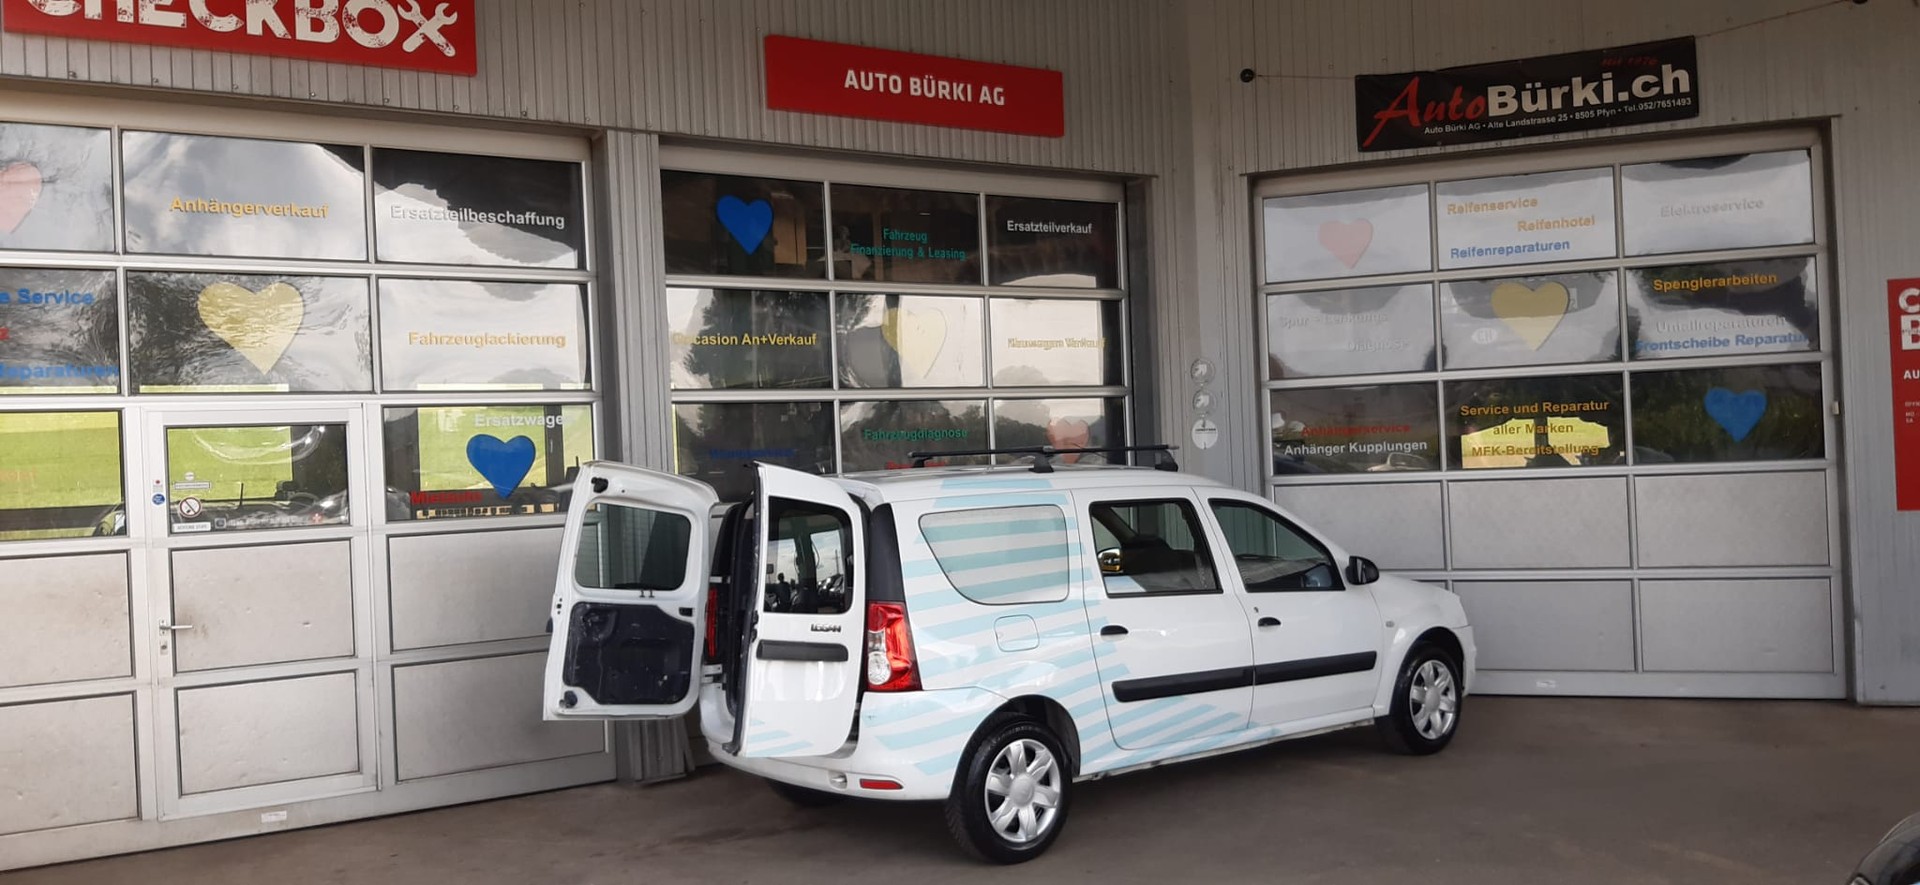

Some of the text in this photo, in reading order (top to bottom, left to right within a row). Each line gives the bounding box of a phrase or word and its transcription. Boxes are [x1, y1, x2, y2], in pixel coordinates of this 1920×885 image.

[844, 69, 1005, 105] AUTO BÜRKI AG
[1424, 126, 1443, 135] Auto
[1445, 124, 1466, 132] Bürki
[1468, 122, 1480, 130] AG
[1488, 121, 1503, 129] Alte
[1505, 115, 1556, 128] Landstrasse
[1557, 113, 1568, 121] 25
[1575, 110, 1595, 120] 8505
[170, 196, 329, 218] Anhängerverkauf
[1447, 197, 1539, 215] Reifenservice
[391, 205, 565, 229] Ersatzteilbeschaffung
[1517, 214, 1596, 232] Reifenhotel
[1006, 220, 1092, 234] Ersatzteilverkauf
[883, 228, 928, 244] Fahrzeug
[850, 243, 966, 262] Finanzierung & Leasing
[1450, 240, 1571, 259] Reifenreparaturen
[1653, 274, 1777, 294] Spenglerarbeiten
[17, 288, 96, 305] Service
[408, 332, 566, 349] Fahrzeuglackierung
[742, 332, 817, 345] An+Verkauf
[1460, 400, 1610, 416] Service und Reparatur
[863, 427, 969, 441] Fahrzeugdiagnose
[1493, 422, 1574, 435] aller Marken
[1284, 440, 1428, 456] Anhänger Kupplungen
